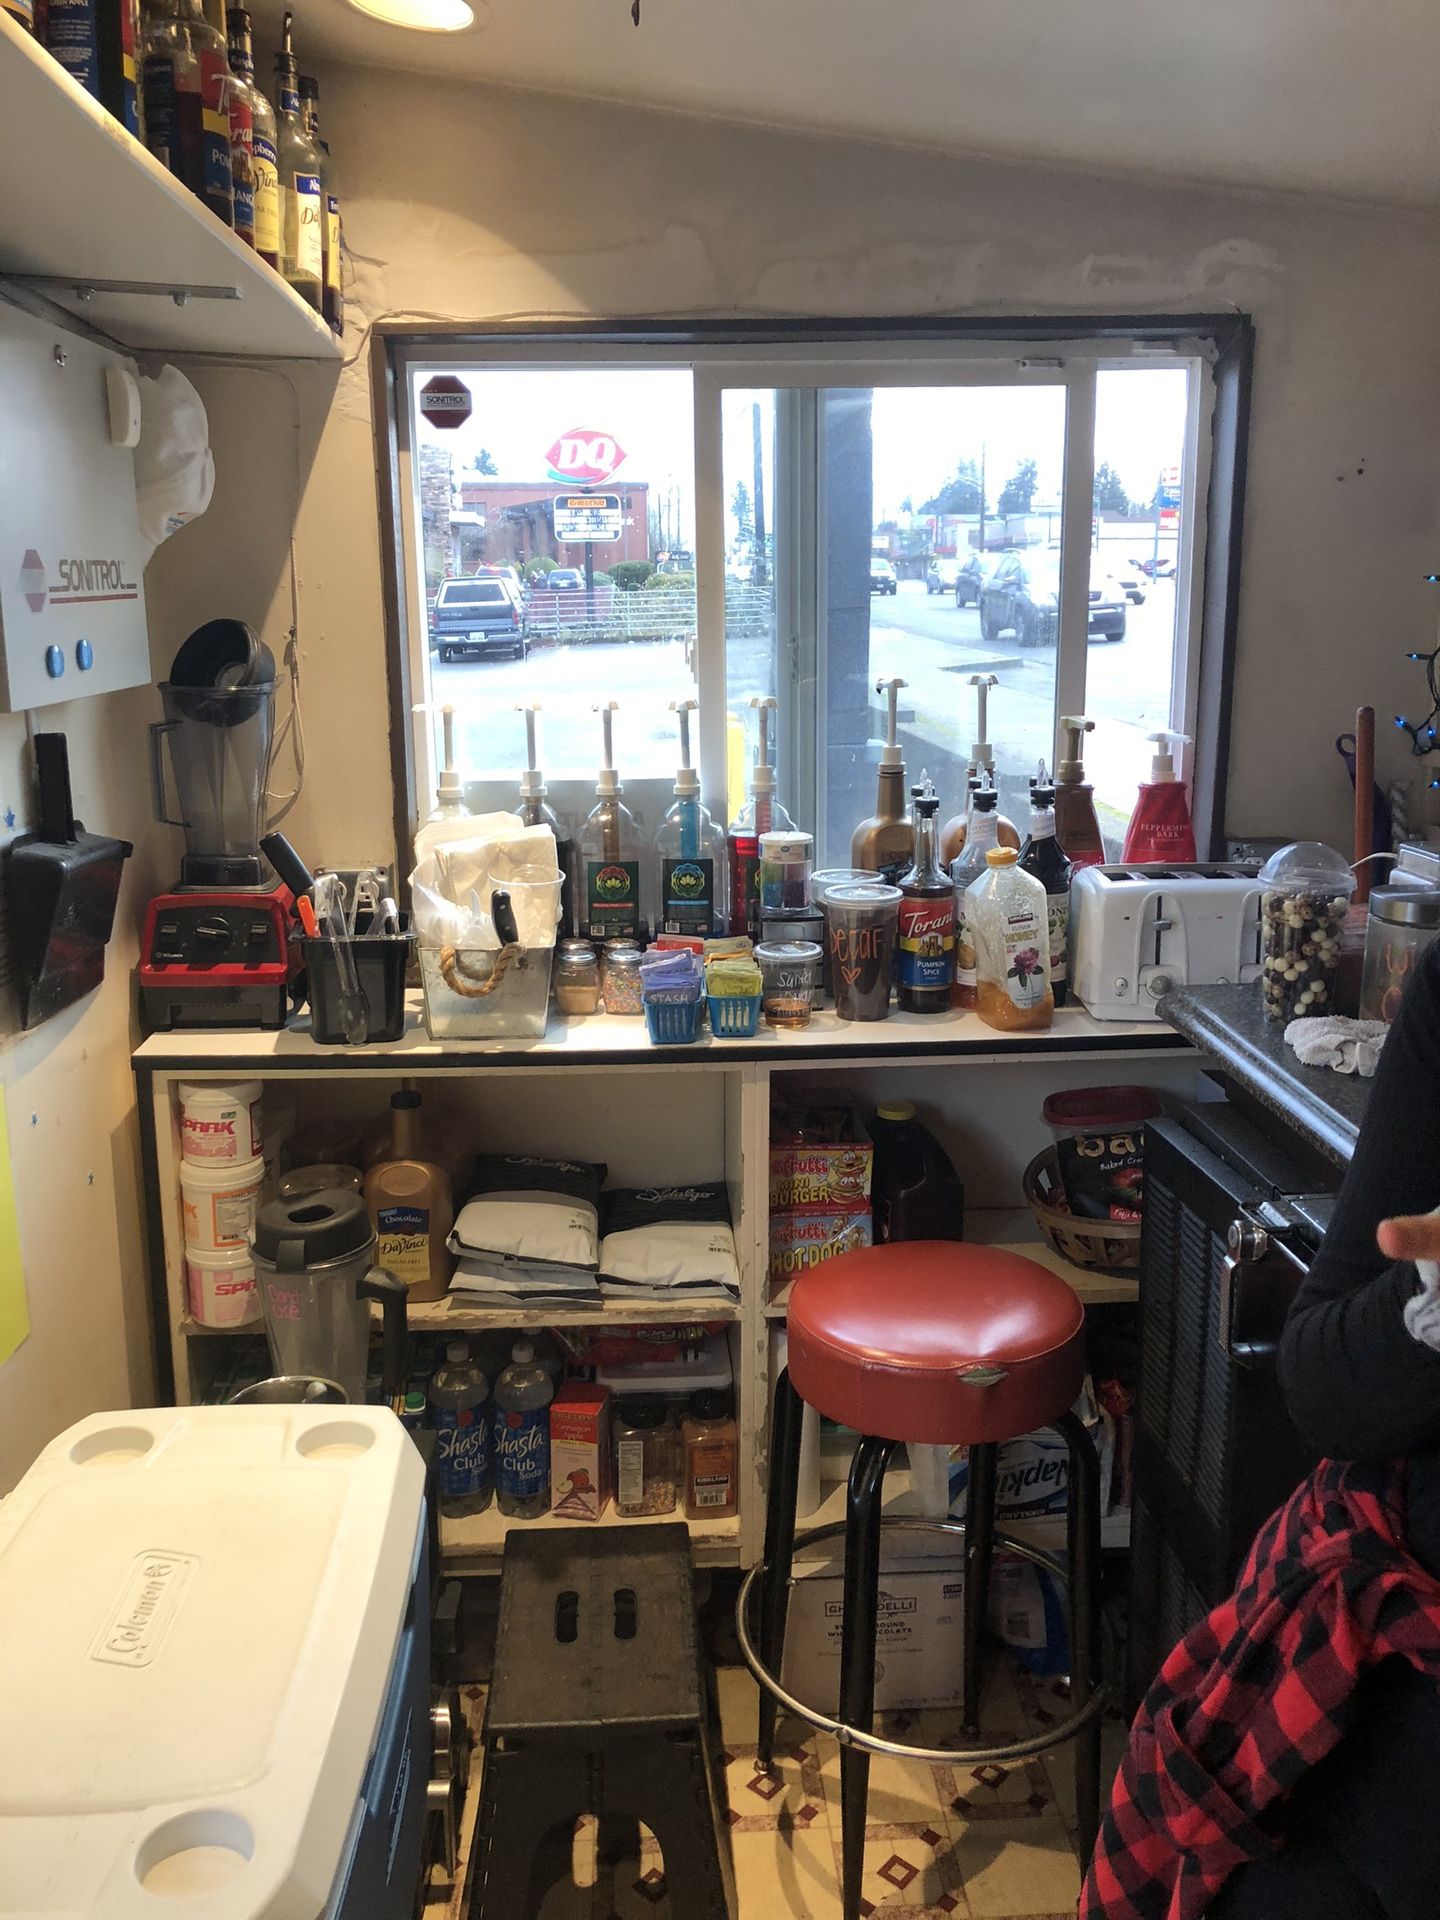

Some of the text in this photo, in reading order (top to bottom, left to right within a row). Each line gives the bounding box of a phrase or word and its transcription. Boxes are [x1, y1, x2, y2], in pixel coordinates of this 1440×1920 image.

[426, 395, 464, 404] SONITROL
[558, 437, 617, 473] DQ
[58, 558, 126, 593] SONITROL
[1004, 928, 1039, 944] HONEY
[916, 960, 945, 968] PUMPKIN
[922, 968, 940, 976] SPICE
[650, 993, 689, 1004] STASH
[1100, 1158, 1124, 1171] Baked
[771, 1185, 829, 1206] BURGER
[385, 1214, 423, 1224] Chocolate
[381, 1237, 426, 1255] DaVinci
[770, 1246, 806, 1274] HOT
[556, 1423, 592, 1433] Cinnamon
[562, 1431, 585, 1440] Apple
[453, 1452, 486, 1471] Club
[503, 1456, 536, 1472] Club
[106, 1584, 166, 1652] Coleman
